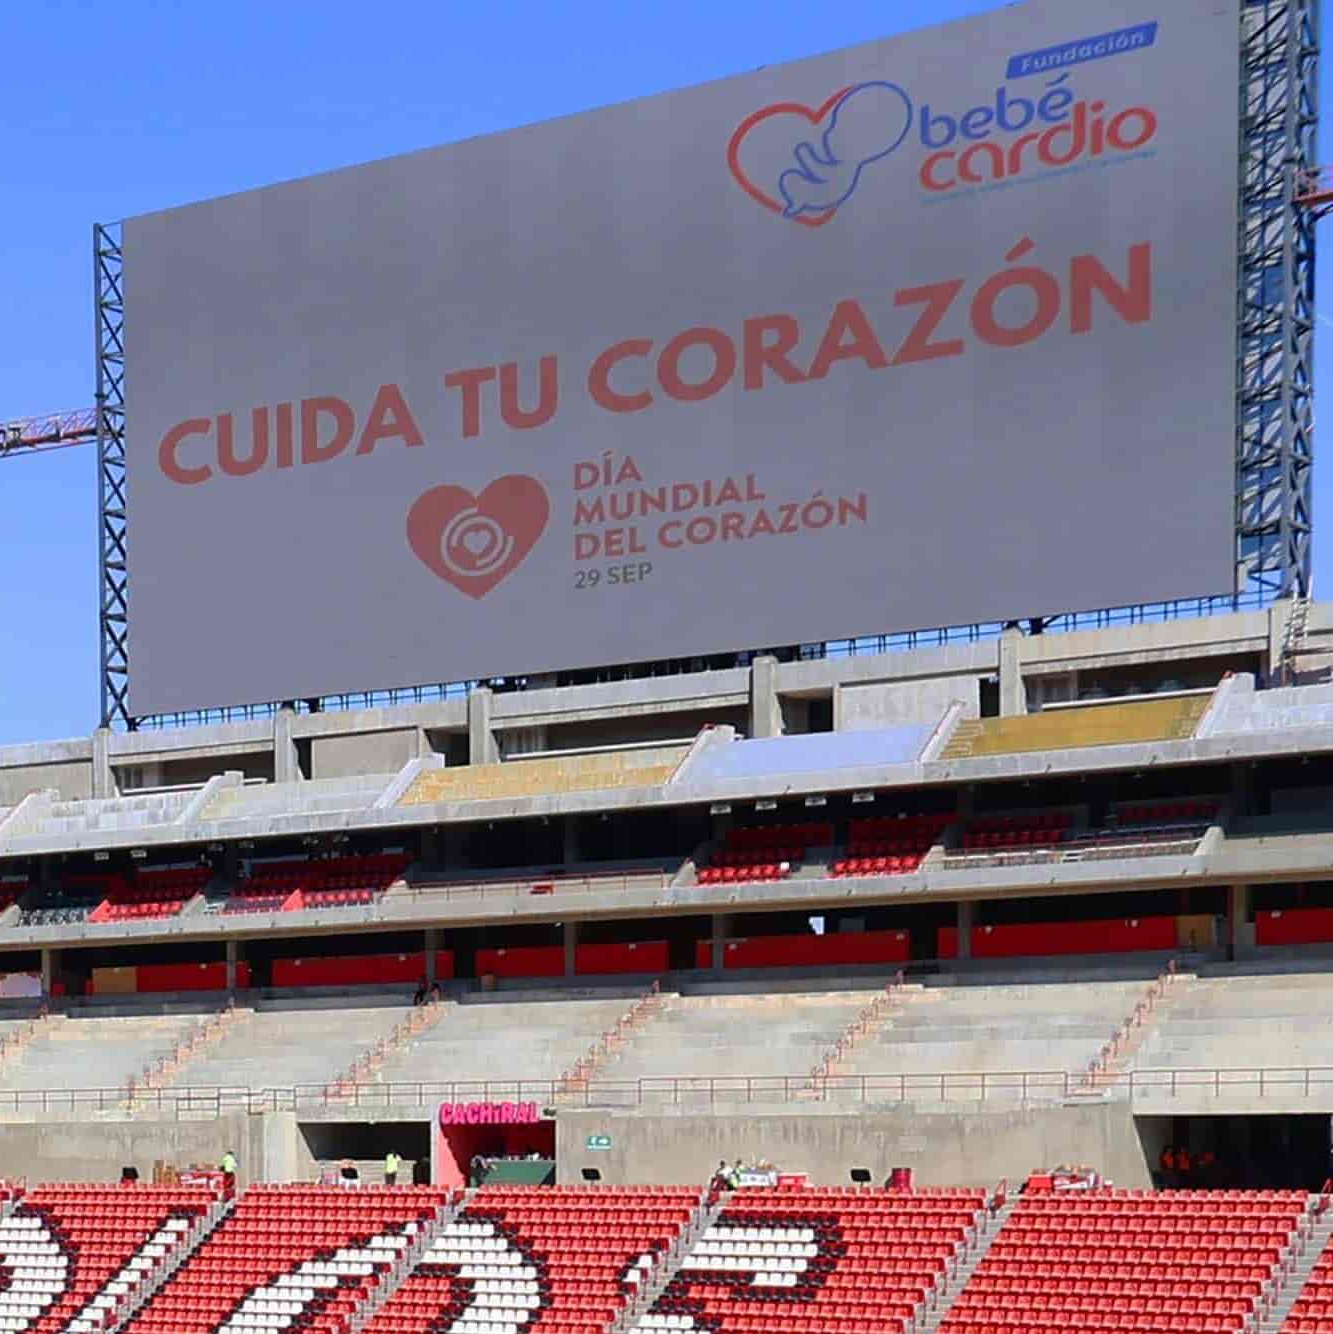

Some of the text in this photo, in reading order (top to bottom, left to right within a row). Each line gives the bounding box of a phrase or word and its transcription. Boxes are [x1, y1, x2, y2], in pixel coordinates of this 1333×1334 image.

[1020, 32, 1146, 74] Fundación
[920, 72, 1075, 149] bebé
[919, 100, 1158, 192] cardio
[158, 238, 1153, 485] CUIDA TU CORAZÓN
[573, 449, 643, 490] DÍA
[573, 473, 767, 526] MUNDIAL
[574, 490, 869, 561] DEL CORAZÓN
[574, 561, 654, 589] 29 SEP
